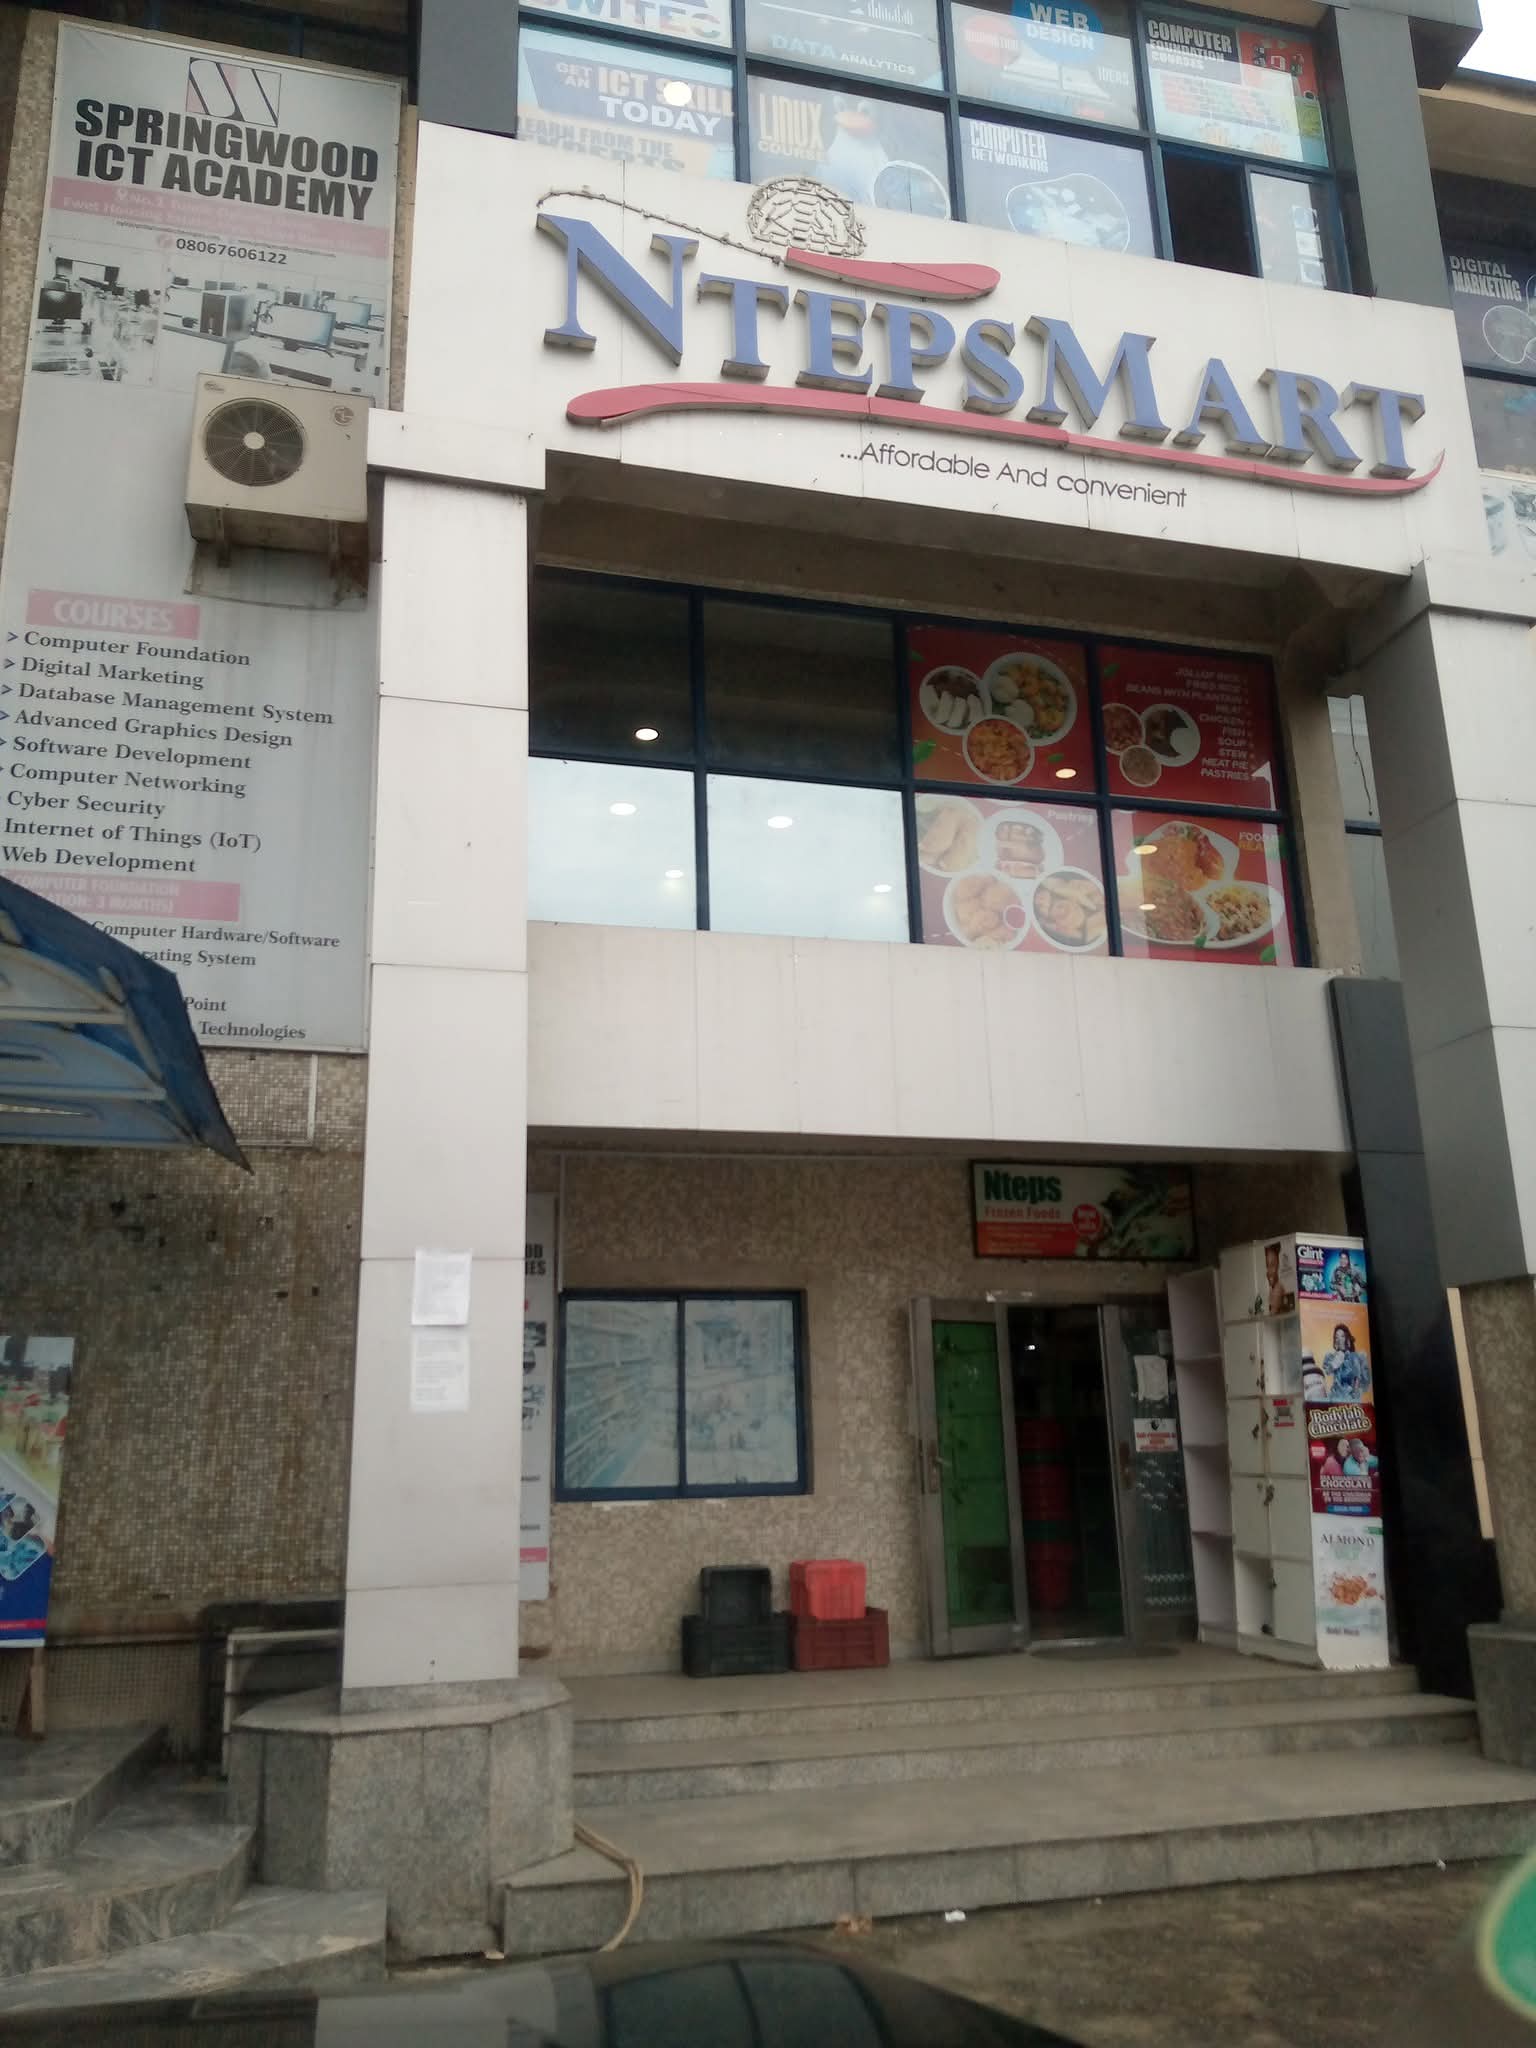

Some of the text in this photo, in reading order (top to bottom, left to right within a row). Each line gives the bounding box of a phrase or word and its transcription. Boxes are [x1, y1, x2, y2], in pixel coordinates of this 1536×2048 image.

[1029, 2, 1089, 32] WEB
[1025, 24, 1095, 50] DESIGN
[1147, 19, 1232, 54] COMPUTER
[556, 63, 592, 77] GET
[840, 52, 915, 75] ANALYTICS
[564, 75, 591, 89] AN
[598, 66, 649, 100] ICT
[599, 95, 721, 137] TODAY
[75, 98, 380, 183] SPRINGWOOD
[969, 121, 1047, 161] COMPUTER
[971, 147, 1048, 174] NETWORKING
[76, 141, 154, 186] ICT
[161, 152, 375, 222] ACADEMY
[175, 236, 288, 266] 08067606122
[1449, 255, 1512, 278] DIGITAL
[1451, 270, 1522, 302] MARKETING
[996, 462, 1047, 488] And
[1057, 474, 1187, 508] convenient
[54, 599, 175, 633] COURSES
[24, 630, 250, 666] Computer Foundation
[22, 656, 204, 691] Digital Marketing
[18, 682, 333, 724] Database Management System
[14, 709, 293, 750] Advanced Graphics Design
[1217, 736, 1247, 747] SOUP
[13, 736, 251, 768] Software Development
[1202, 757, 1229, 768] MEAT
[1218, 748, 1248, 759] STEW
[10, 762, 246, 799] Computer Networking
[1201, 768, 1249, 781] PASTRIES
[7, 790, 166, 819] Cyber Security
[4, 817, 261, 854] Internet of Things (IoT)
[2, 845, 195, 873] Web Development
[92, 921, 340, 948] Computer Hardware/Software
[196, 949, 257, 968] System
[184, 996, 227, 1012] Point
[199, 1021, 306, 1042] Technologies
[984, 1170, 1062, 1205] Nteps
[1297, 1245, 1324, 1261] Glint
[1310, 1418, 1370, 1435] Chocolate
[1312, 1406, 1362, 1424] Bodylab
[1319, 1533, 1375, 1547] ALMOND
